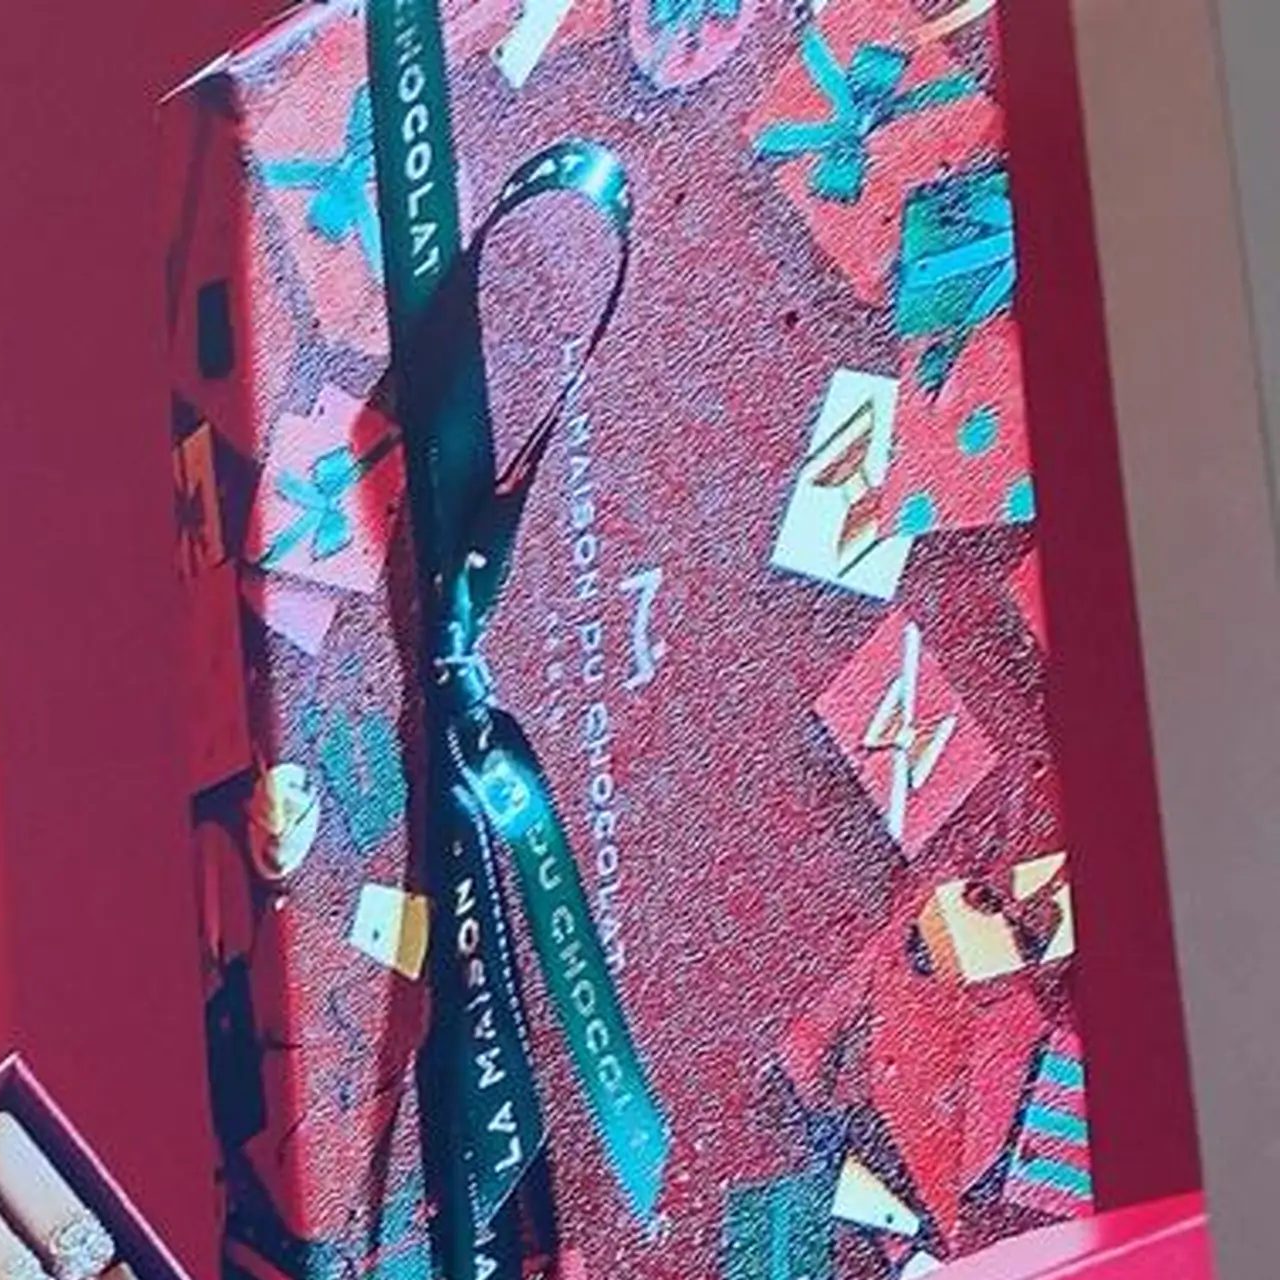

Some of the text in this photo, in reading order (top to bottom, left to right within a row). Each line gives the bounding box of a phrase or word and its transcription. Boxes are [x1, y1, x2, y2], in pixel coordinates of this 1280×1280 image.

[565, 413, 599, 600] MAISON
[578, 622, 605, 684] DU
[585, 702, 626, 975] CHOCOLAT
[453, 878, 523, 1174] LA MAISON
